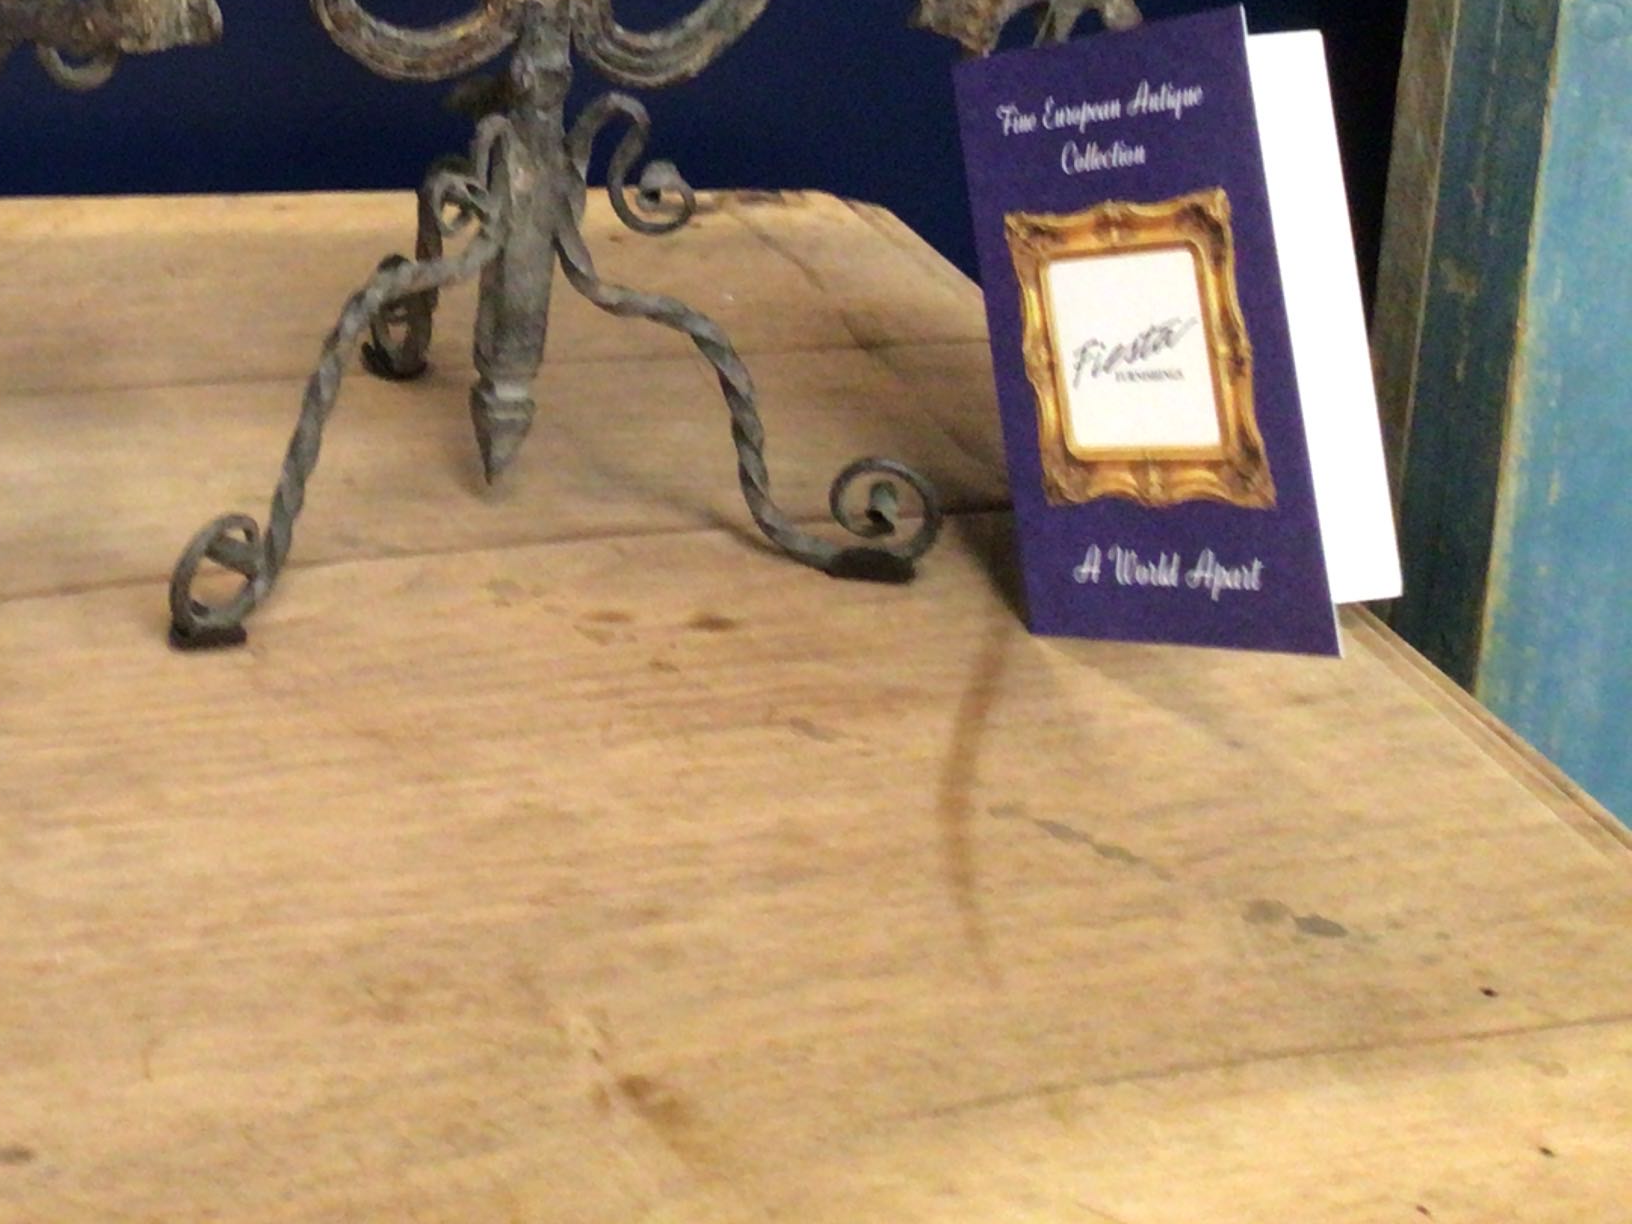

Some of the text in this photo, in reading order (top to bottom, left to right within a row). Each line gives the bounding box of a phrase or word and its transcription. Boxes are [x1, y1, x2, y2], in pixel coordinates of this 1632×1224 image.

[996, 79, 1204, 137] Fine European Antique
[1061, 139, 1146, 176] Collection
[1072, 543, 1264, 602] A World Apart
